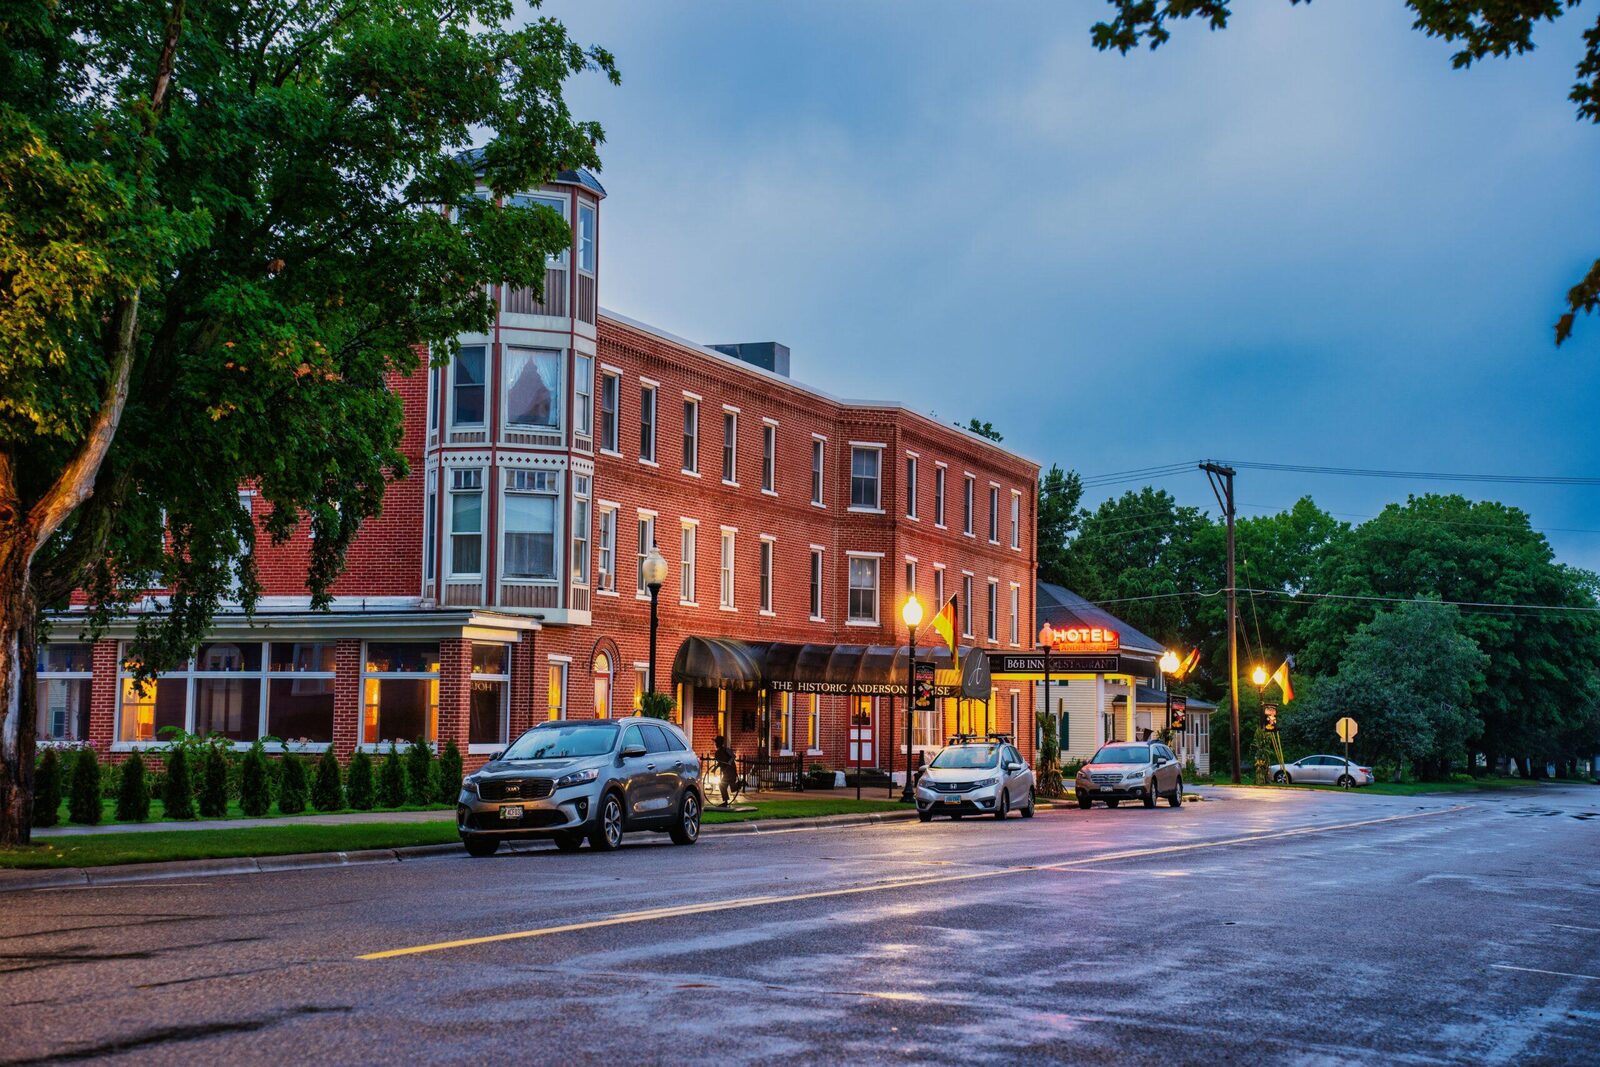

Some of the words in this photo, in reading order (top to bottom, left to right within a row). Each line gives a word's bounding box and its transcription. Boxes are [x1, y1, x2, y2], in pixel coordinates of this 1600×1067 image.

[1053, 629, 1114, 642] HOTEL
[1007, 659, 1025, 669] B&B
[1027, 659, 1045, 669] INN
[1053, 659, 1116, 669] ESTAURANT
[772, 681, 793, 690] THE
[798, 682, 847, 693] HISTORIC
[849, 684, 908, 694] ANDERSON
